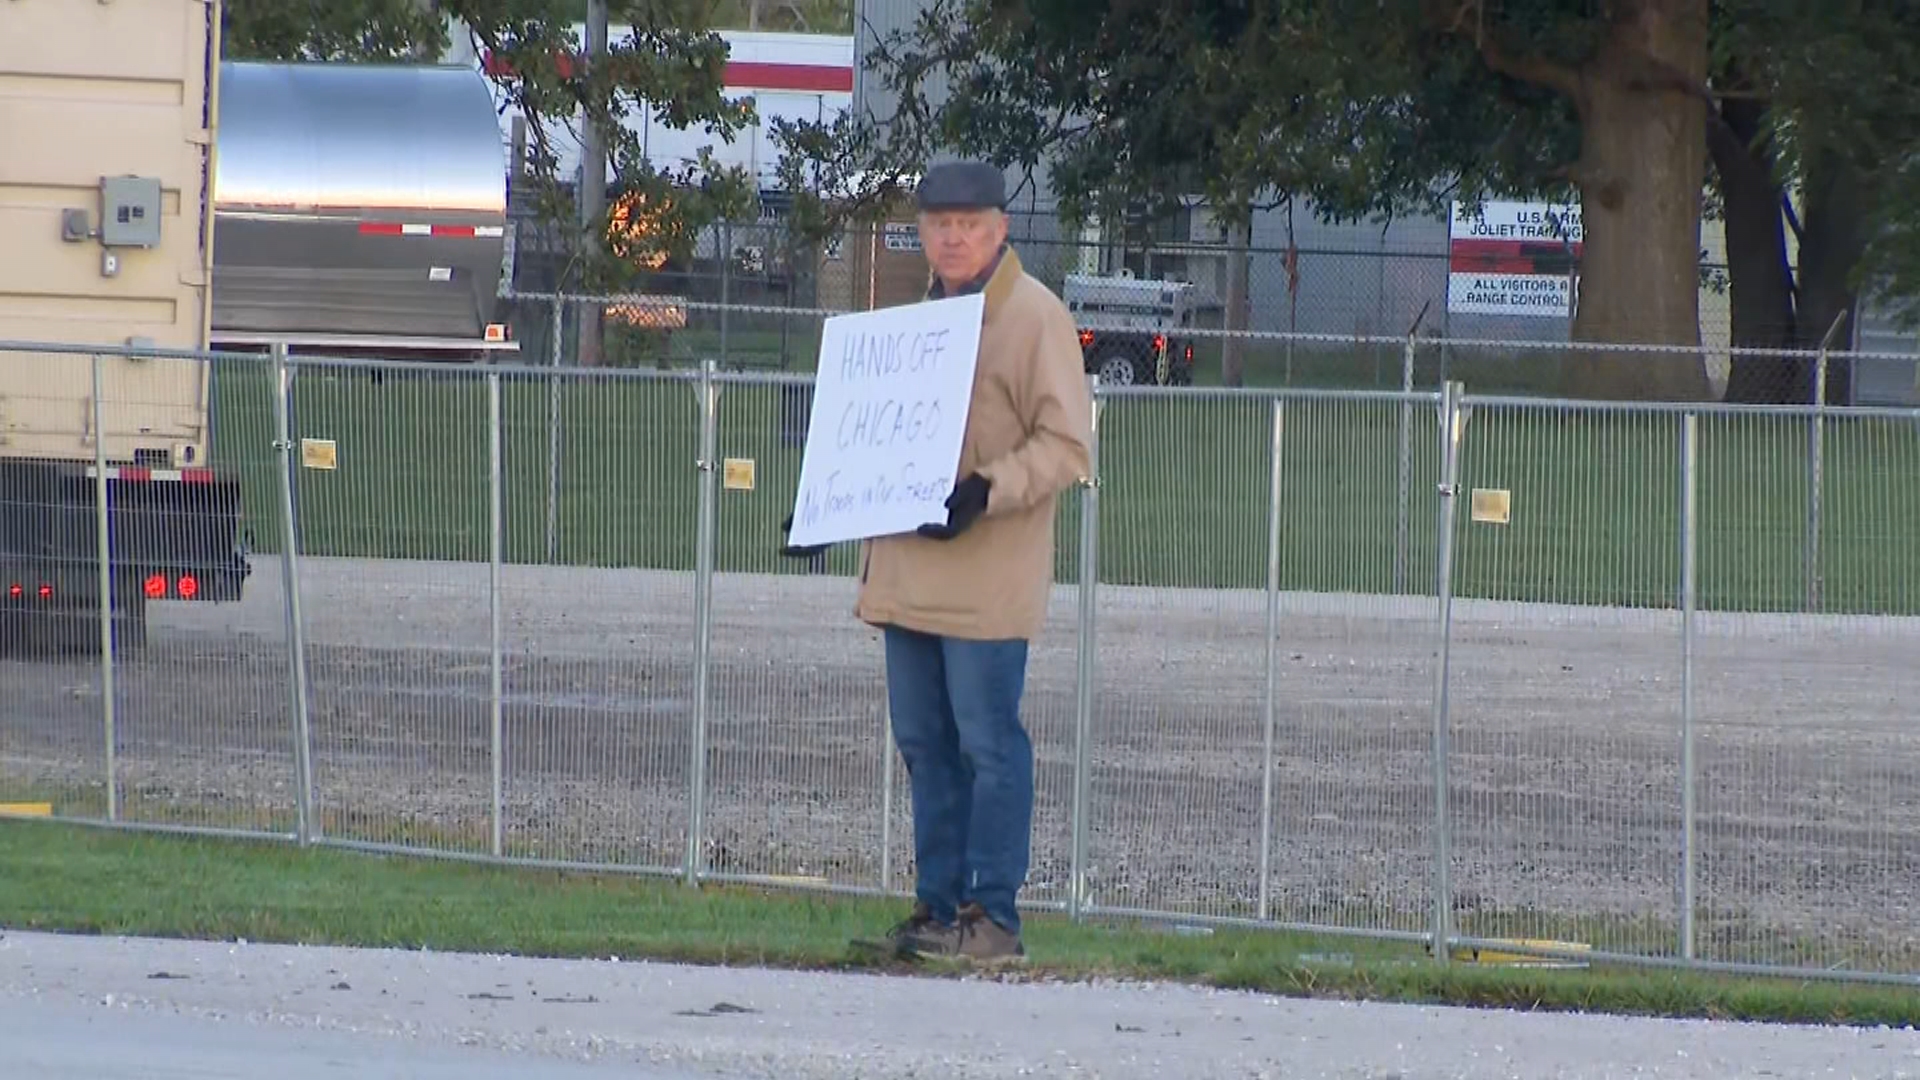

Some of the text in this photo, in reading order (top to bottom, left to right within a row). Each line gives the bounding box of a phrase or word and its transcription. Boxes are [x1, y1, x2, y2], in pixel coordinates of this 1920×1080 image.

[1470, 224, 1516, 236] JOLIET
[1474, 279, 1497, 290] ALL
[1501, 280, 1556, 291] VISITORS
[1467, 292, 1566, 306] RANGE CONTROL
[841, 328, 950, 382] HANDS OFF
[837, 399, 942, 451] CHICAGO
